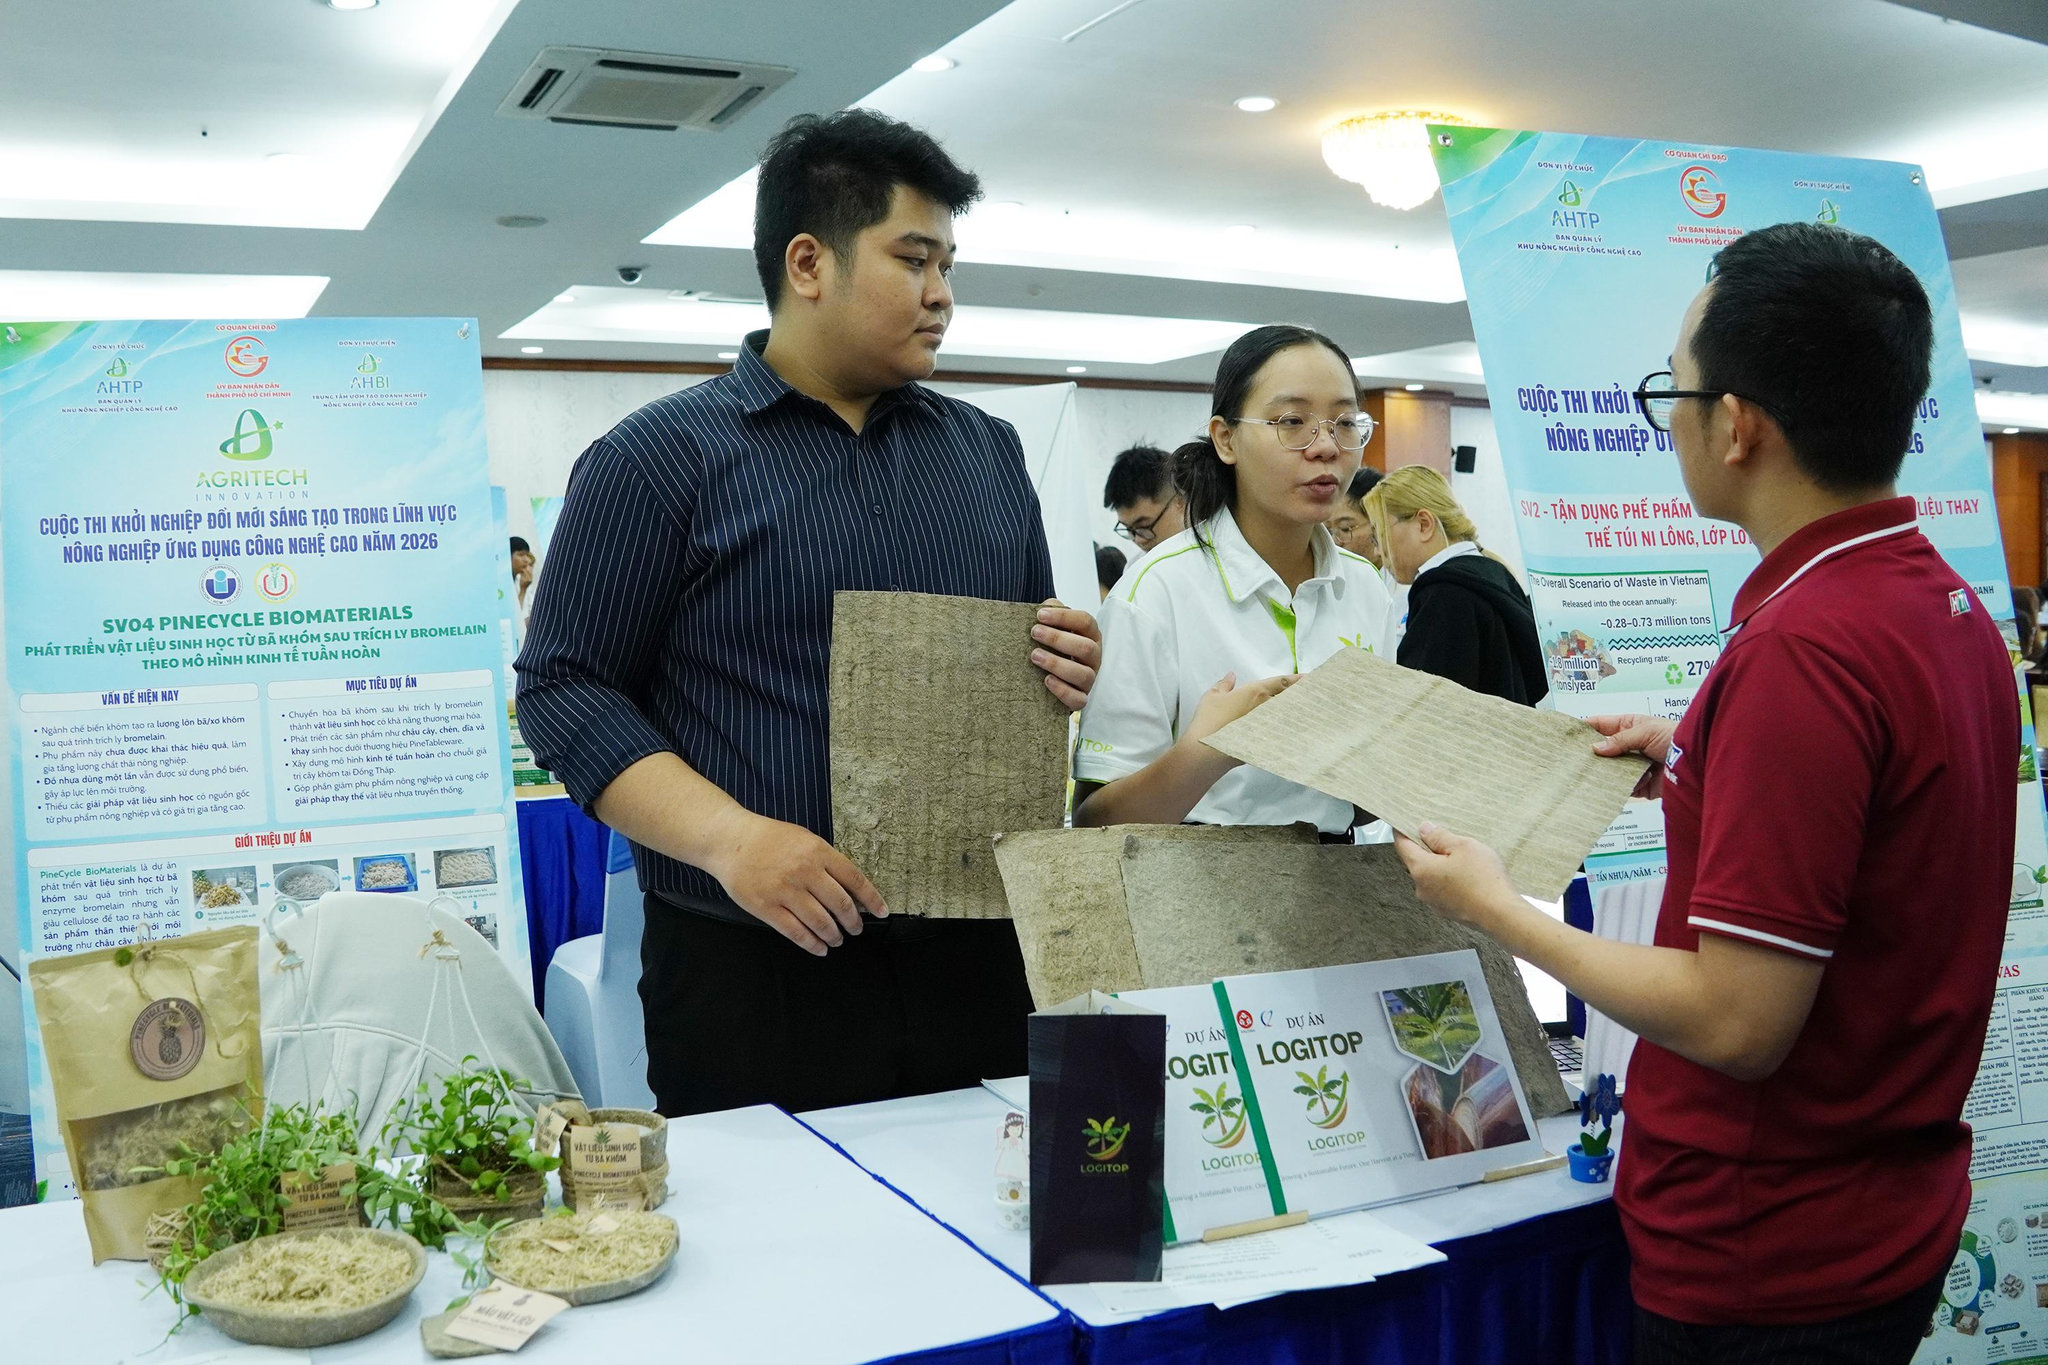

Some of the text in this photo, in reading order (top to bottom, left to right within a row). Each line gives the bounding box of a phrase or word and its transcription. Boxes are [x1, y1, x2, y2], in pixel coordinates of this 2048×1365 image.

[1676, 152, 1696, 160] QUAN
[1712, 154, 1727, 163] ĐẠO
[1555, 162, 1563, 172] VỊ
[1552, 210, 1600, 229] AHTP
[1594, 234, 1602, 242] LÝ
[1706, 226, 1726, 234] NHÂN
[1728, 226, 1742, 236] DÂN
[1668, 235, 1693, 243] THÀNH
[1695, 234, 1710, 244] PHỐ
[1712, 235, 1722, 245] HỒ
[1536, 242, 1558, 251] NÔNG
[1558, 244, 1585, 254] NGHIỆP
[1586, 244, 1606, 254] CÔNG
[1607, 247, 1626, 256] NGHỆ
[96, 380, 142, 394] AHTP
[350, 377, 388, 388] AHBI
[1518, 382, 1939, 423] CUỘC THI KHỞI ỰC
[1545, 422, 1650, 456] NÔNG NGHIỆP
[196, 469, 308, 488] AGRITECH
[196, 490, 308, 502] INNOVATION
[1521, 500, 1540, 518] SV2
[1550, 498, 1577, 524] TẬN
[1582, 502, 1618, 524] DỤNG
[1622, 497, 1649, 519] PHẾ
[1917, 496, 1943, 519] LIỆU
[1946, 499, 1979, 515] THAY
[40, 502, 457, 538] CUỘC THI KHỞI NGHIỆP ĐỔI MỚI SÁNG TẠO TRONG LĨNH VỰC
[1585, 525, 1727, 548] THẾ TÚI NI LÔNG, LỚP
[63, 530, 438, 564] NÔNG NGHIỆP ỨNG DỤNG CÔNG NGHỆ CAO NĂM 2026
[1529, 575, 1708, 590] The Overall Scenario of Waste in Vietnam
[1973, 586, 1994, 594] OANH
[1562, 600, 1592, 608] Released
[1609, 599, 1620, 607] the
[1645, 597, 1677, 607] annually:
[103, 605, 413, 634] SV04 PINECYCLE BIOMATERIALS
[1656, 616, 1688, 627] million
[1690, 615, 1711, 625] tons
[25, 624, 487, 657] PHÁT TRIỂN VẬT LIỆU SINH HỌC TỪ BÃ KHÓM SAU TRÍCH LY BROMELAIN
[142, 644, 380, 670] THEO MÔ HÌNH KINH TẾ TUẦN HOÀN
[1564, 657, 1598, 670] million
[1618, 655, 1671, 666] Recycling rate:
[346, 674, 417, 693] MỤC TIÊU DỰ ÁN
[102, 688, 179, 706] VẤN ĐỀ HIỆN NAY
[1664, 698, 1690, 707] Hanoi
[124, 732, 166, 743] bromelain.
[1079, 738, 1112, 753] ITOP
[234, 830, 312, 848] GIỚI THIỆU DỰ ÁN
[40, 865, 136, 880] PineCycle BioMaterials
[1286, 1012, 1325, 1030] DỰ ÁN
[1185, 1026, 1226, 1046] DỰ ÁN
[1256, 1031, 1363, 1066] LOGITOP
[1165, 1051, 1229, 1081] OGIT
[1308, 1131, 1366, 1151] LOGITOP
[1080, 1164, 1129, 1173] LOGITOP
